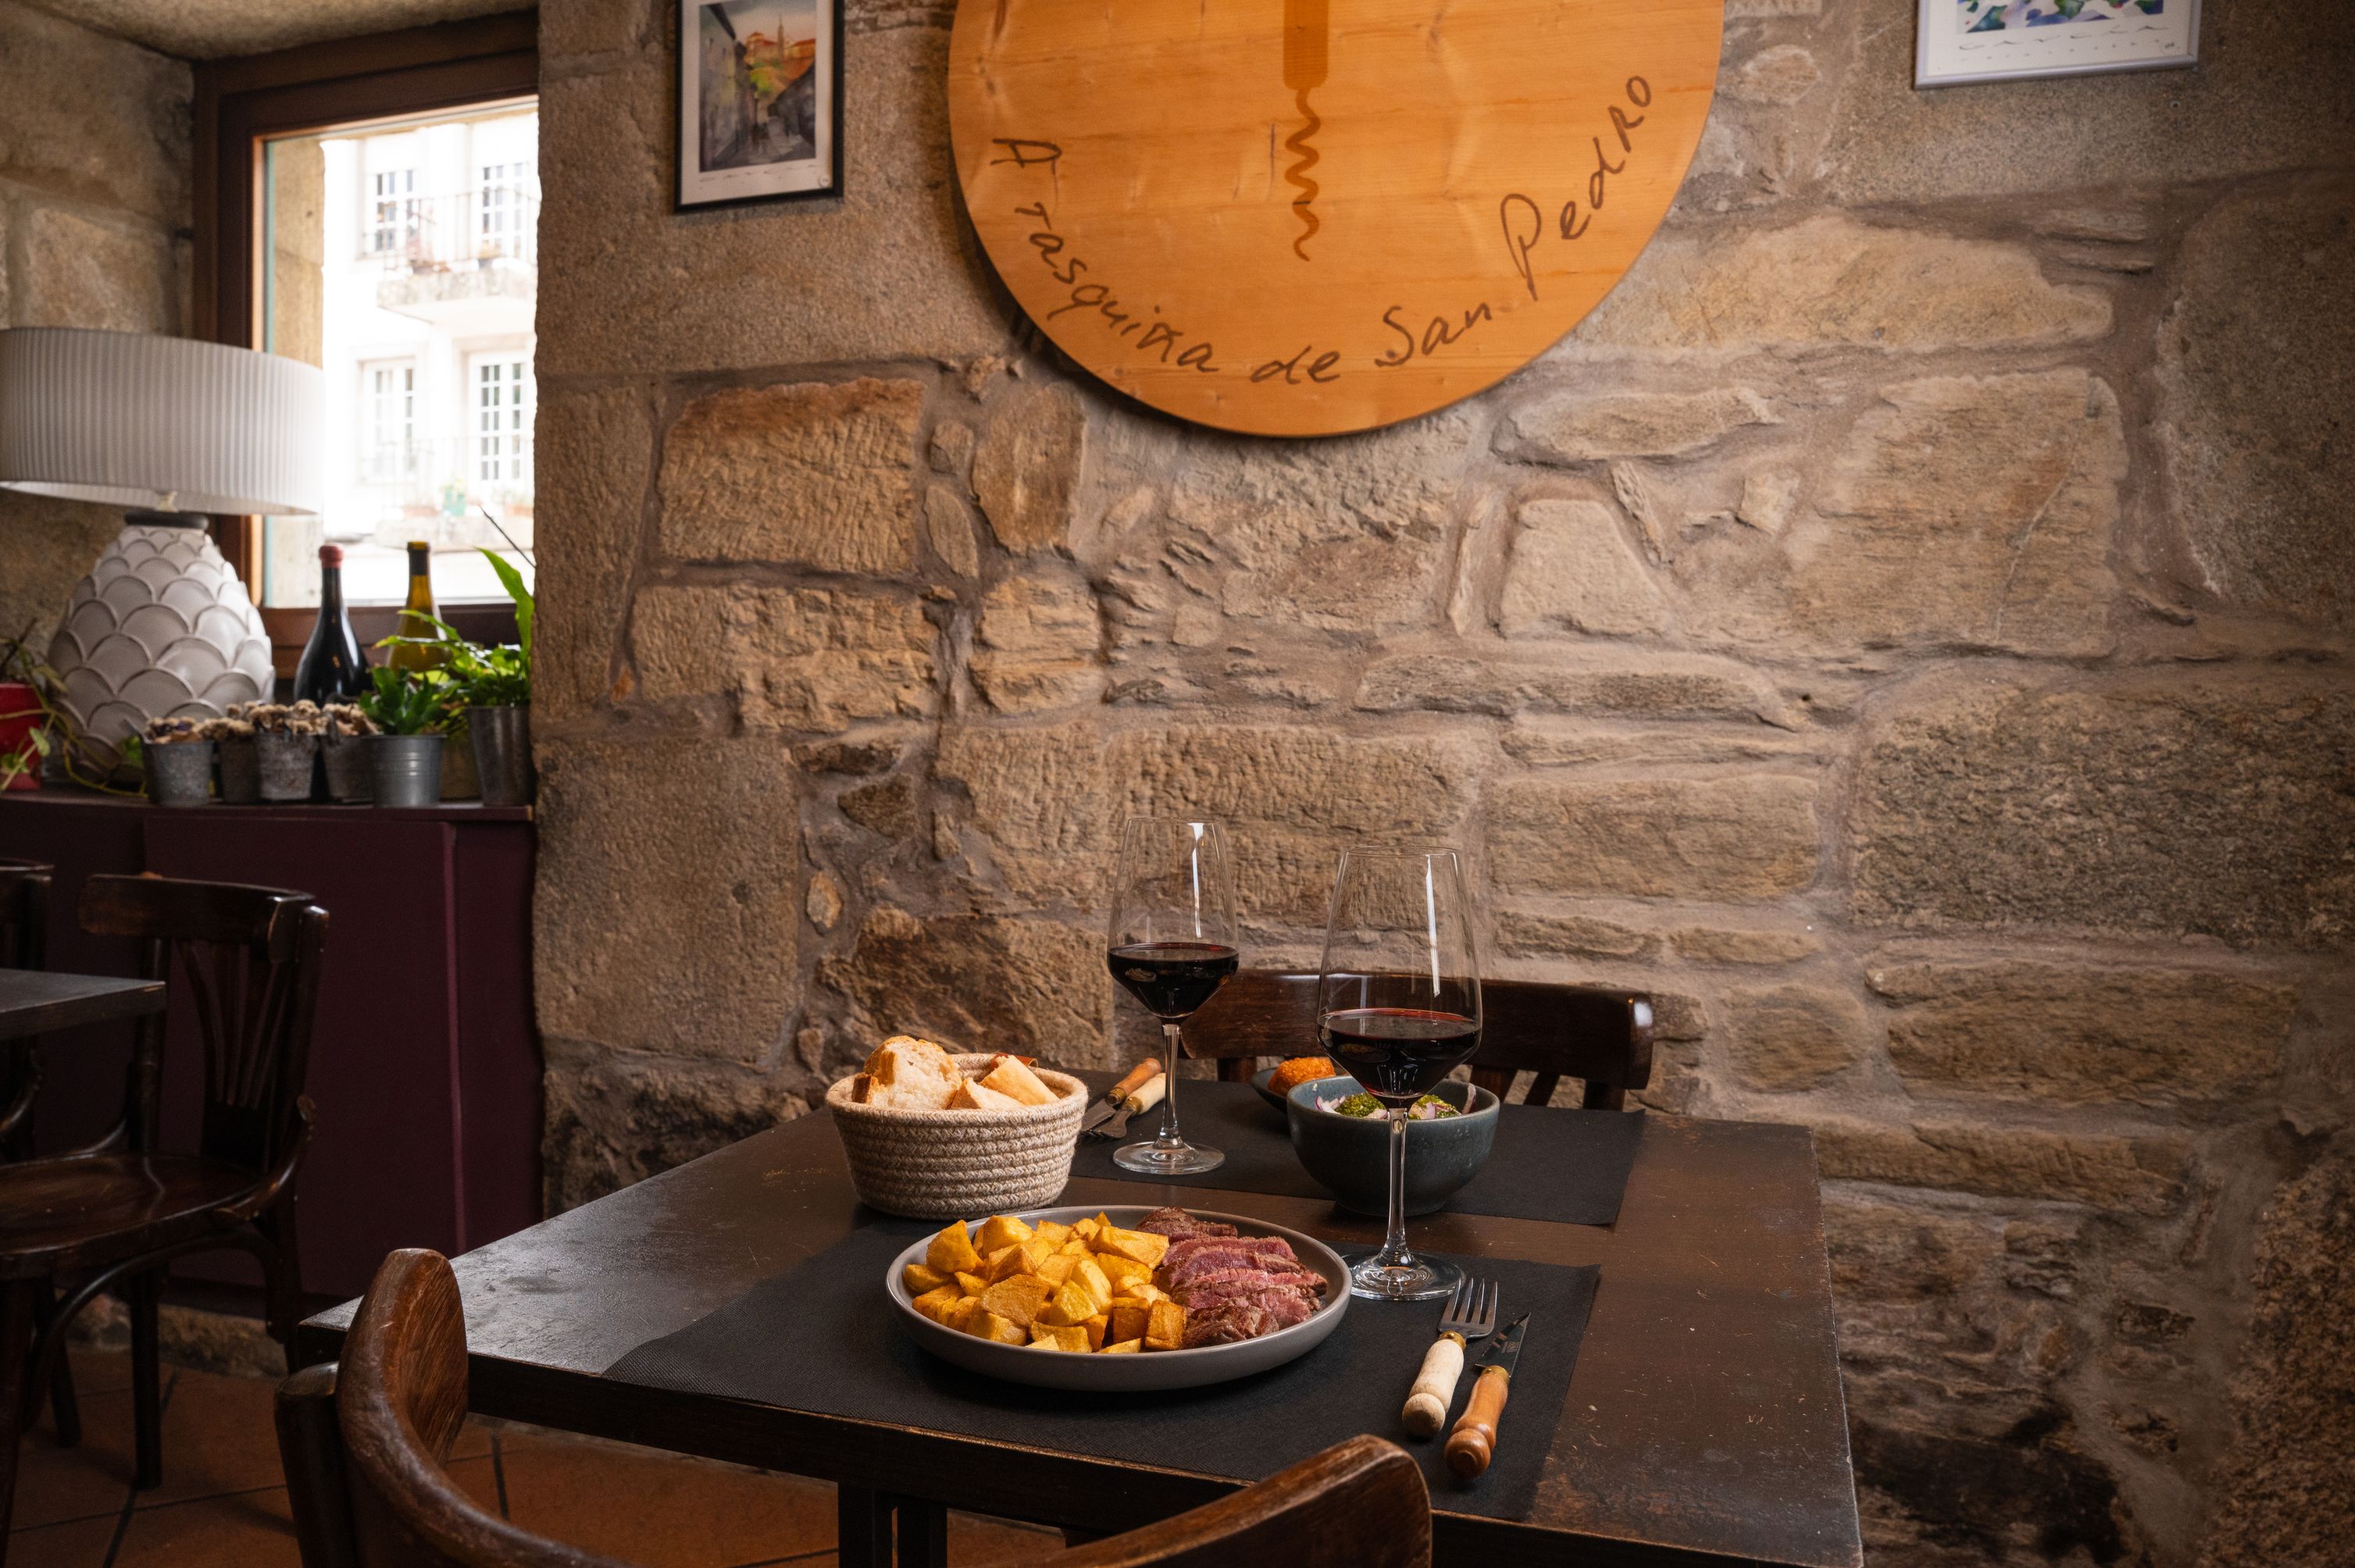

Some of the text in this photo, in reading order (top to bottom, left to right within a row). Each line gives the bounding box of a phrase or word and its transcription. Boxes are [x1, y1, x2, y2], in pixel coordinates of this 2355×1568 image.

[990, 138, 1063, 169] A
[1250, 345, 1341, 385] de
[1373, 305, 1493, 368] San
